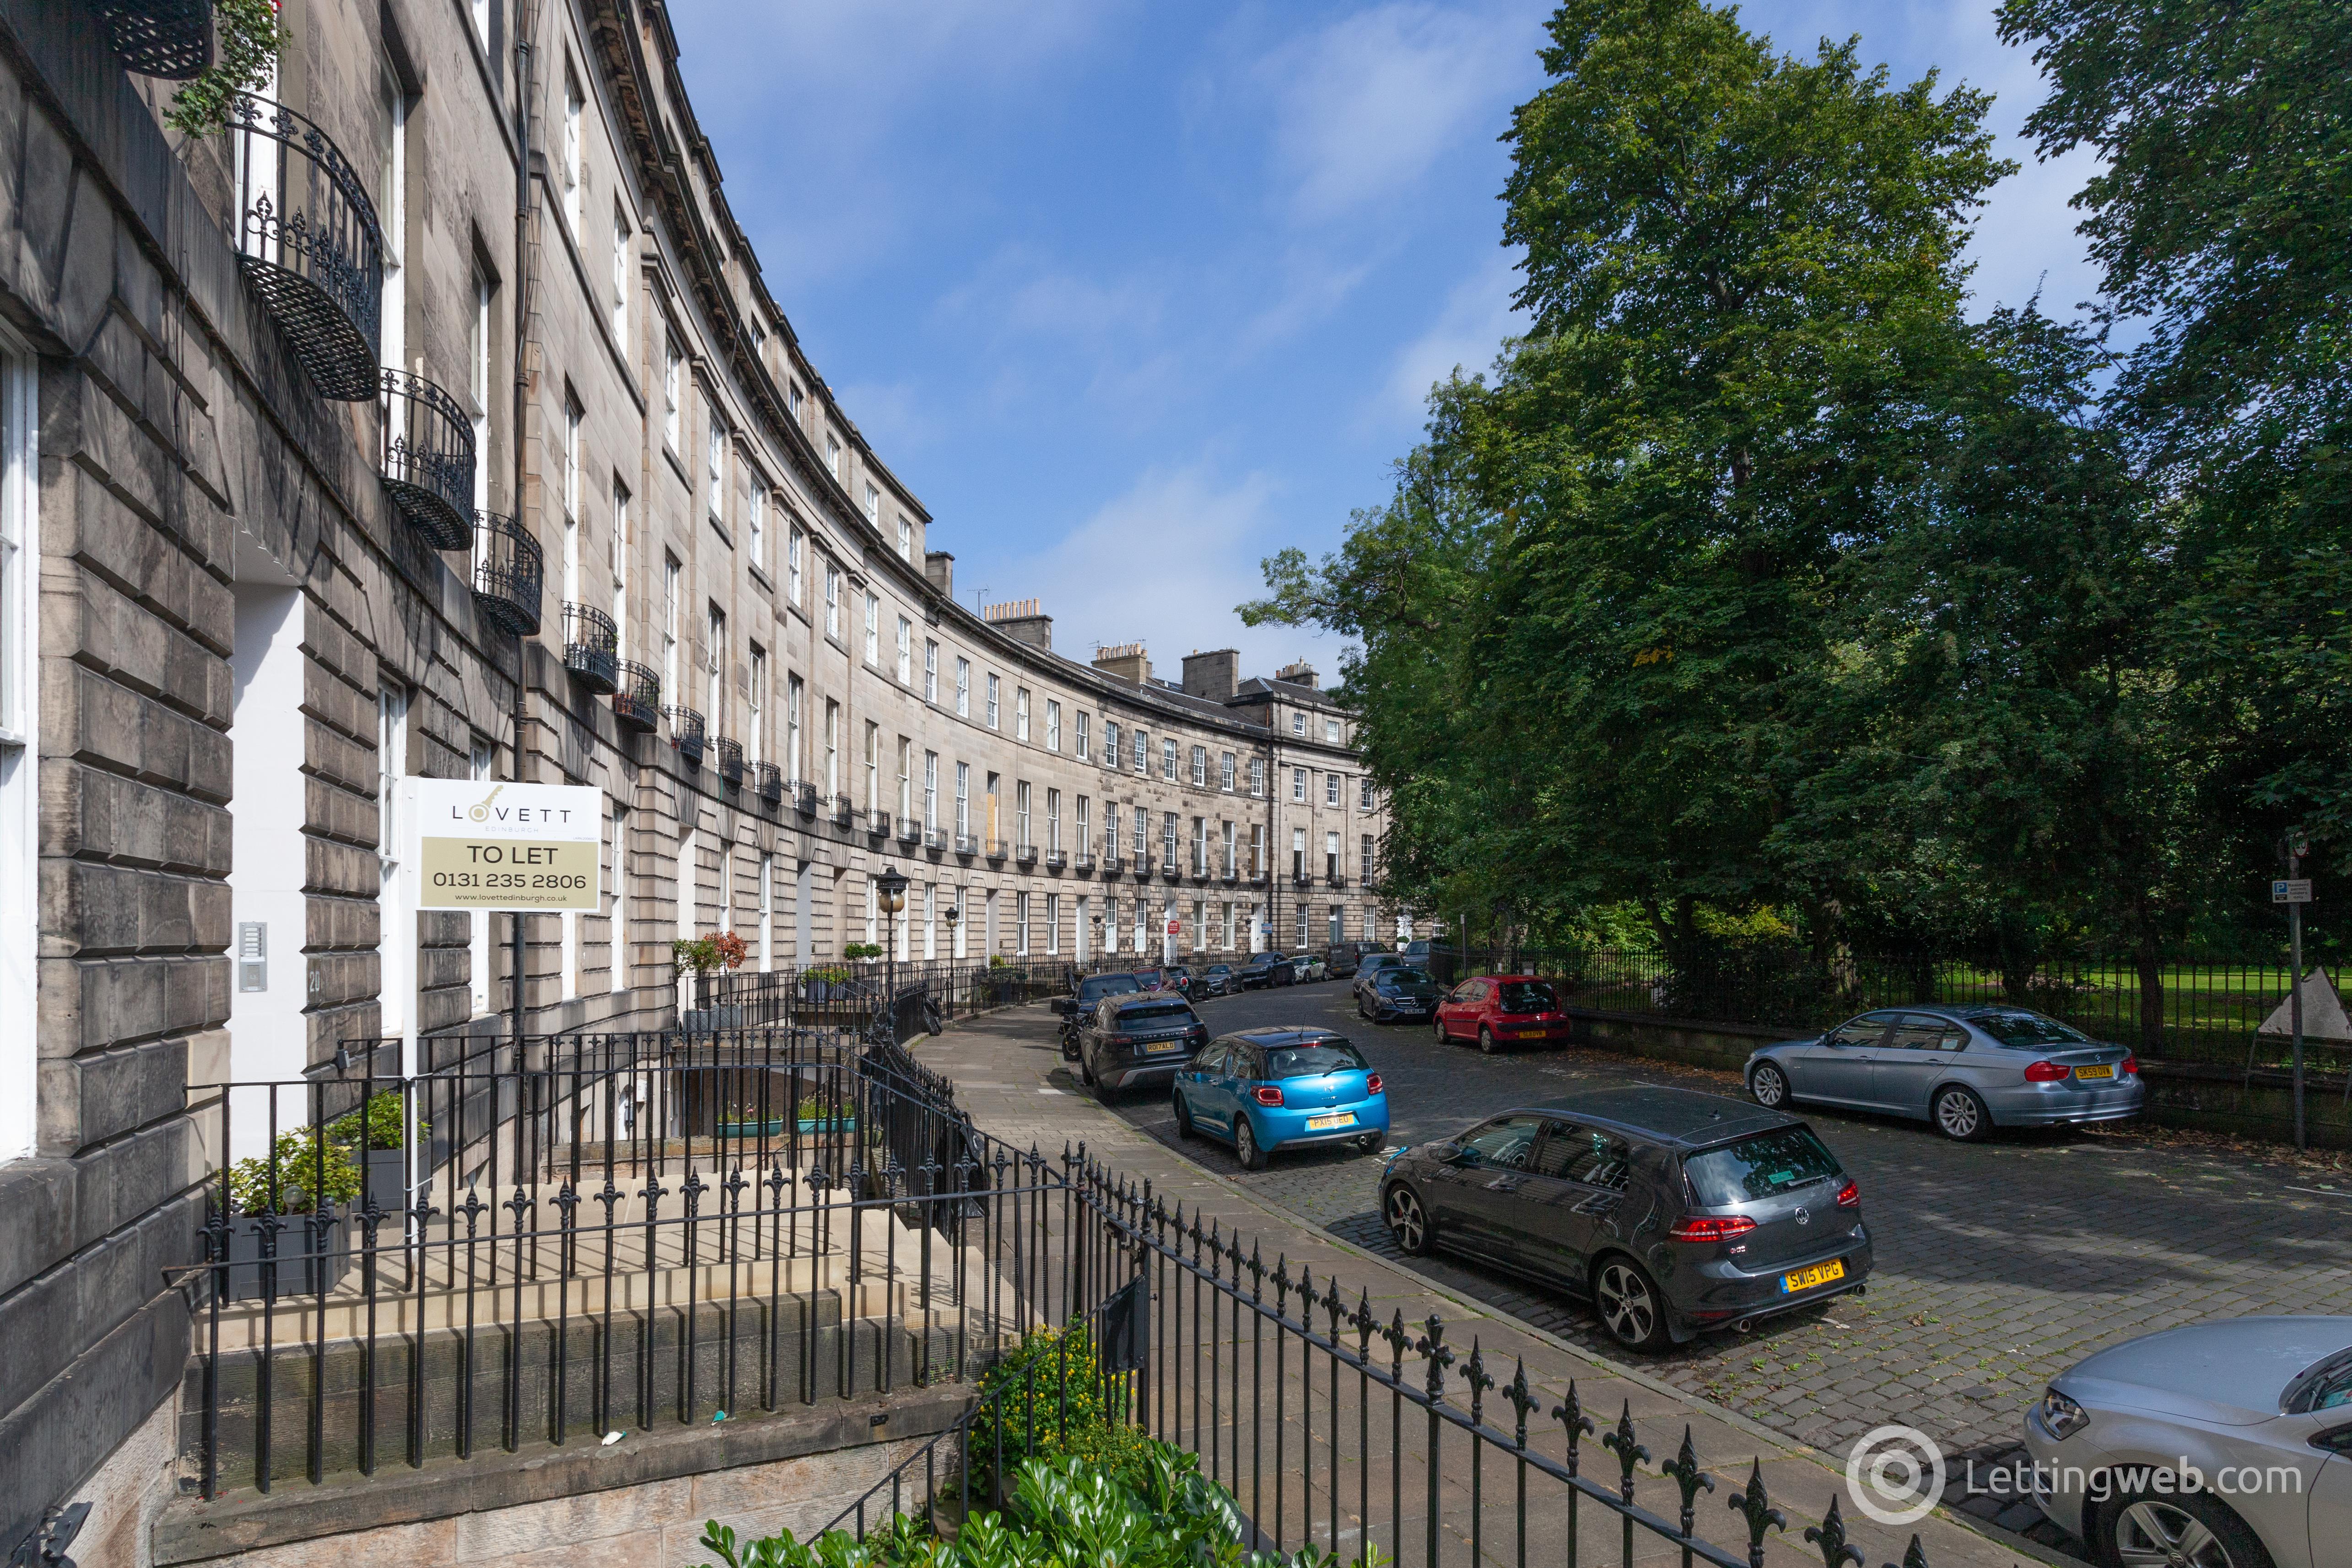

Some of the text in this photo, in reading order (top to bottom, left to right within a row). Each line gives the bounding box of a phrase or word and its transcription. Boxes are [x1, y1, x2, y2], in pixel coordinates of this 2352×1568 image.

[453, 803, 571, 823] LOVETT
[467, 846, 558, 865] TO LET
[433, 872, 586, 889] 0131 235 2806
[2276, 883, 2285, 892] P
[454, 894, 567, 903] www.lovettedinburgh.co.uk
[309, 971, 320, 992] 20
[1314, 1117, 1332, 1127] PX15
[1790, 1262, 1840, 1288] SW15 VPG
